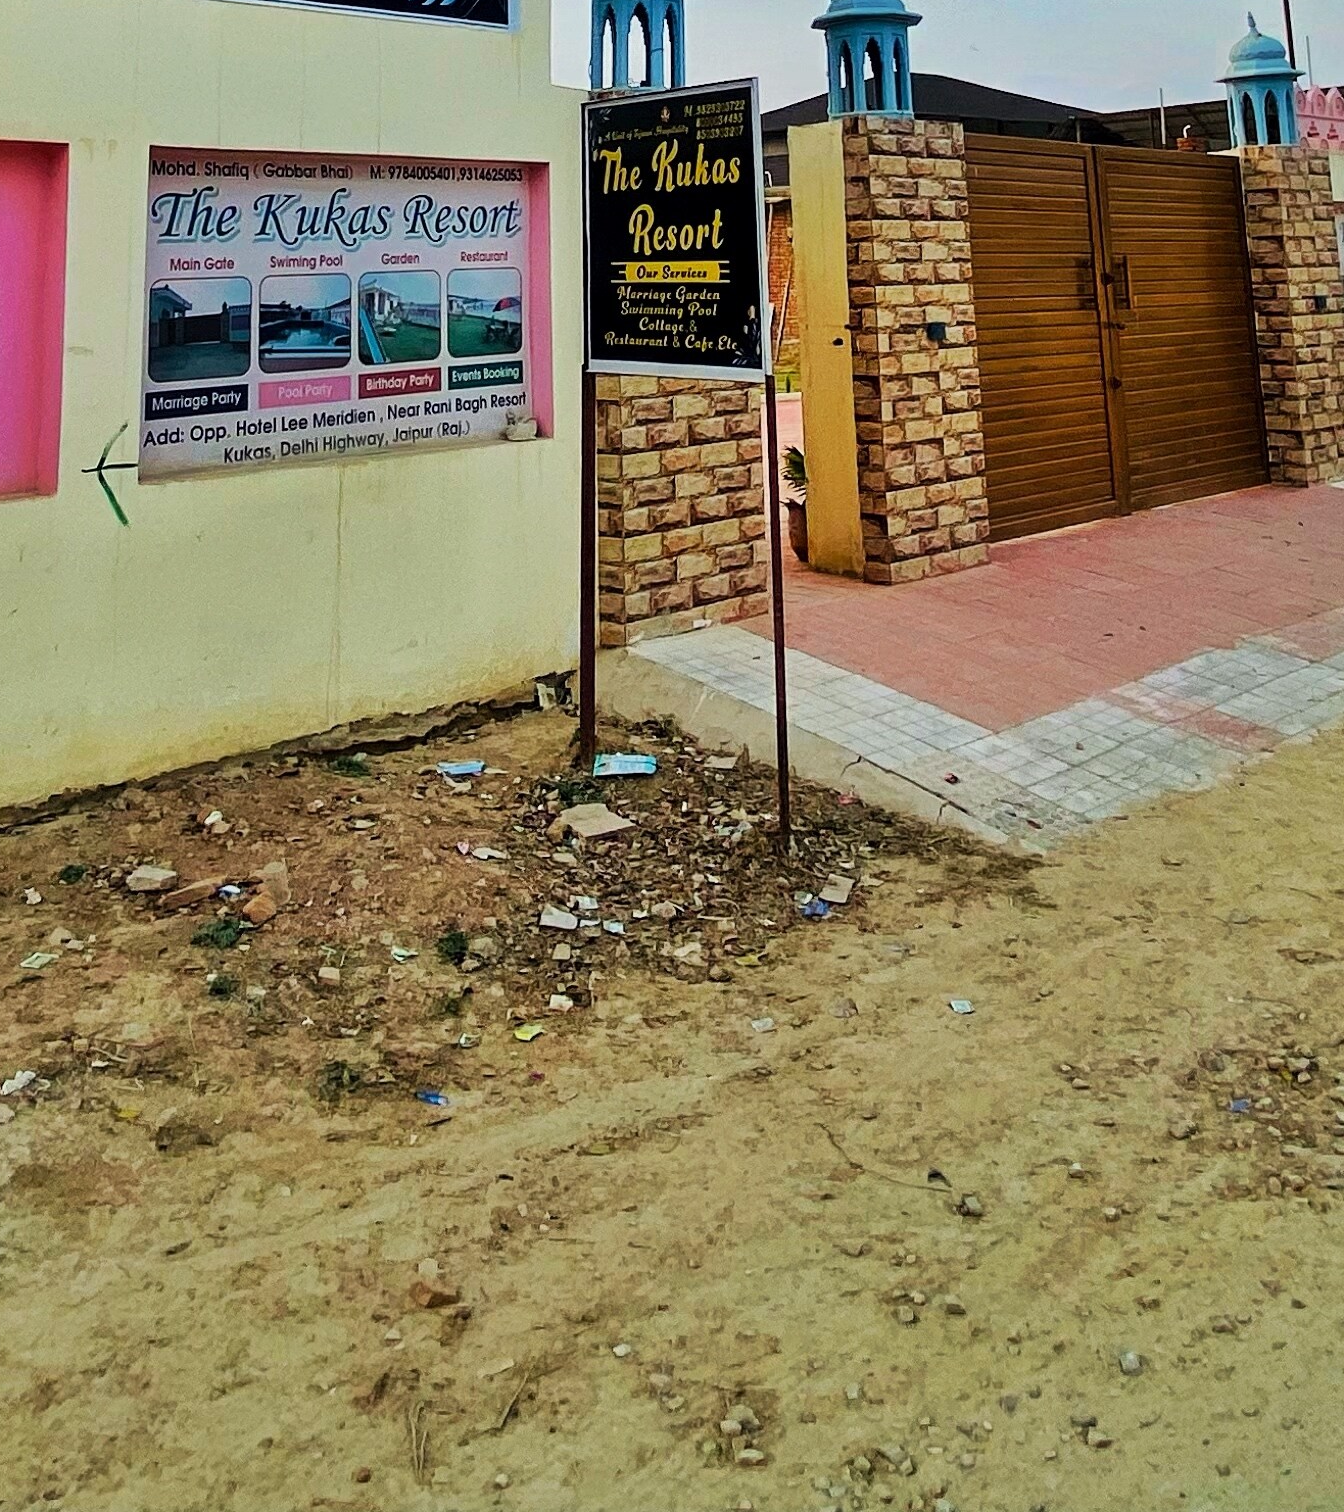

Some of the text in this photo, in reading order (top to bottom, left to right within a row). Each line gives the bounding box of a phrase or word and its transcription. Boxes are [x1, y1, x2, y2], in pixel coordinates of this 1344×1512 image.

[151, 160, 201, 177] Mohd.
[204, 161, 250, 181] Shafiq
[262, 162, 317, 179] Gabbar
[599, 138, 741, 195] The Kukas
[150, 185, 522, 250] The Kukas Resort
[628, 203, 724, 256] Resort
[169, 257, 235, 271] Main Gate
[270, 254, 343, 270] Swiming Pool
[381, 252, 420, 265] Garden
[460, 251, 509, 263] Restaurant
[636, 264, 708, 280] Our Services
[616, 285, 721, 304] Marriage Garden
[620, 300, 718, 320] Swimming Pool
[604, 331, 669, 347] Restaurant
[672, 335, 681, 348] &
[366, 373, 435, 391] Birthday Party
[452, 365, 520, 383] Events Booking
[278, 383, 333, 399] Pool Party
[152, 390, 242, 411] Marriage Party
[143, 428, 185, 448] Add:
[190, 424, 231, 444] Opp.
[236, 416, 277, 437] Hotel
[281, 415, 309, 431] Lee
[312, 407, 376, 430] Meridien
[387, 404, 421, 420] Near
[424, 398, 452, 416] Rani
[455, 394, 488, 414] Bagh
[490, 391, 527, 408] Resort
[223, 445, 276, 464] Kukas,
[280, 438, 319, 457] Delhi
[322, 430, 389, 454] Highway,
[392, 425, 433, 444] Jaipur
